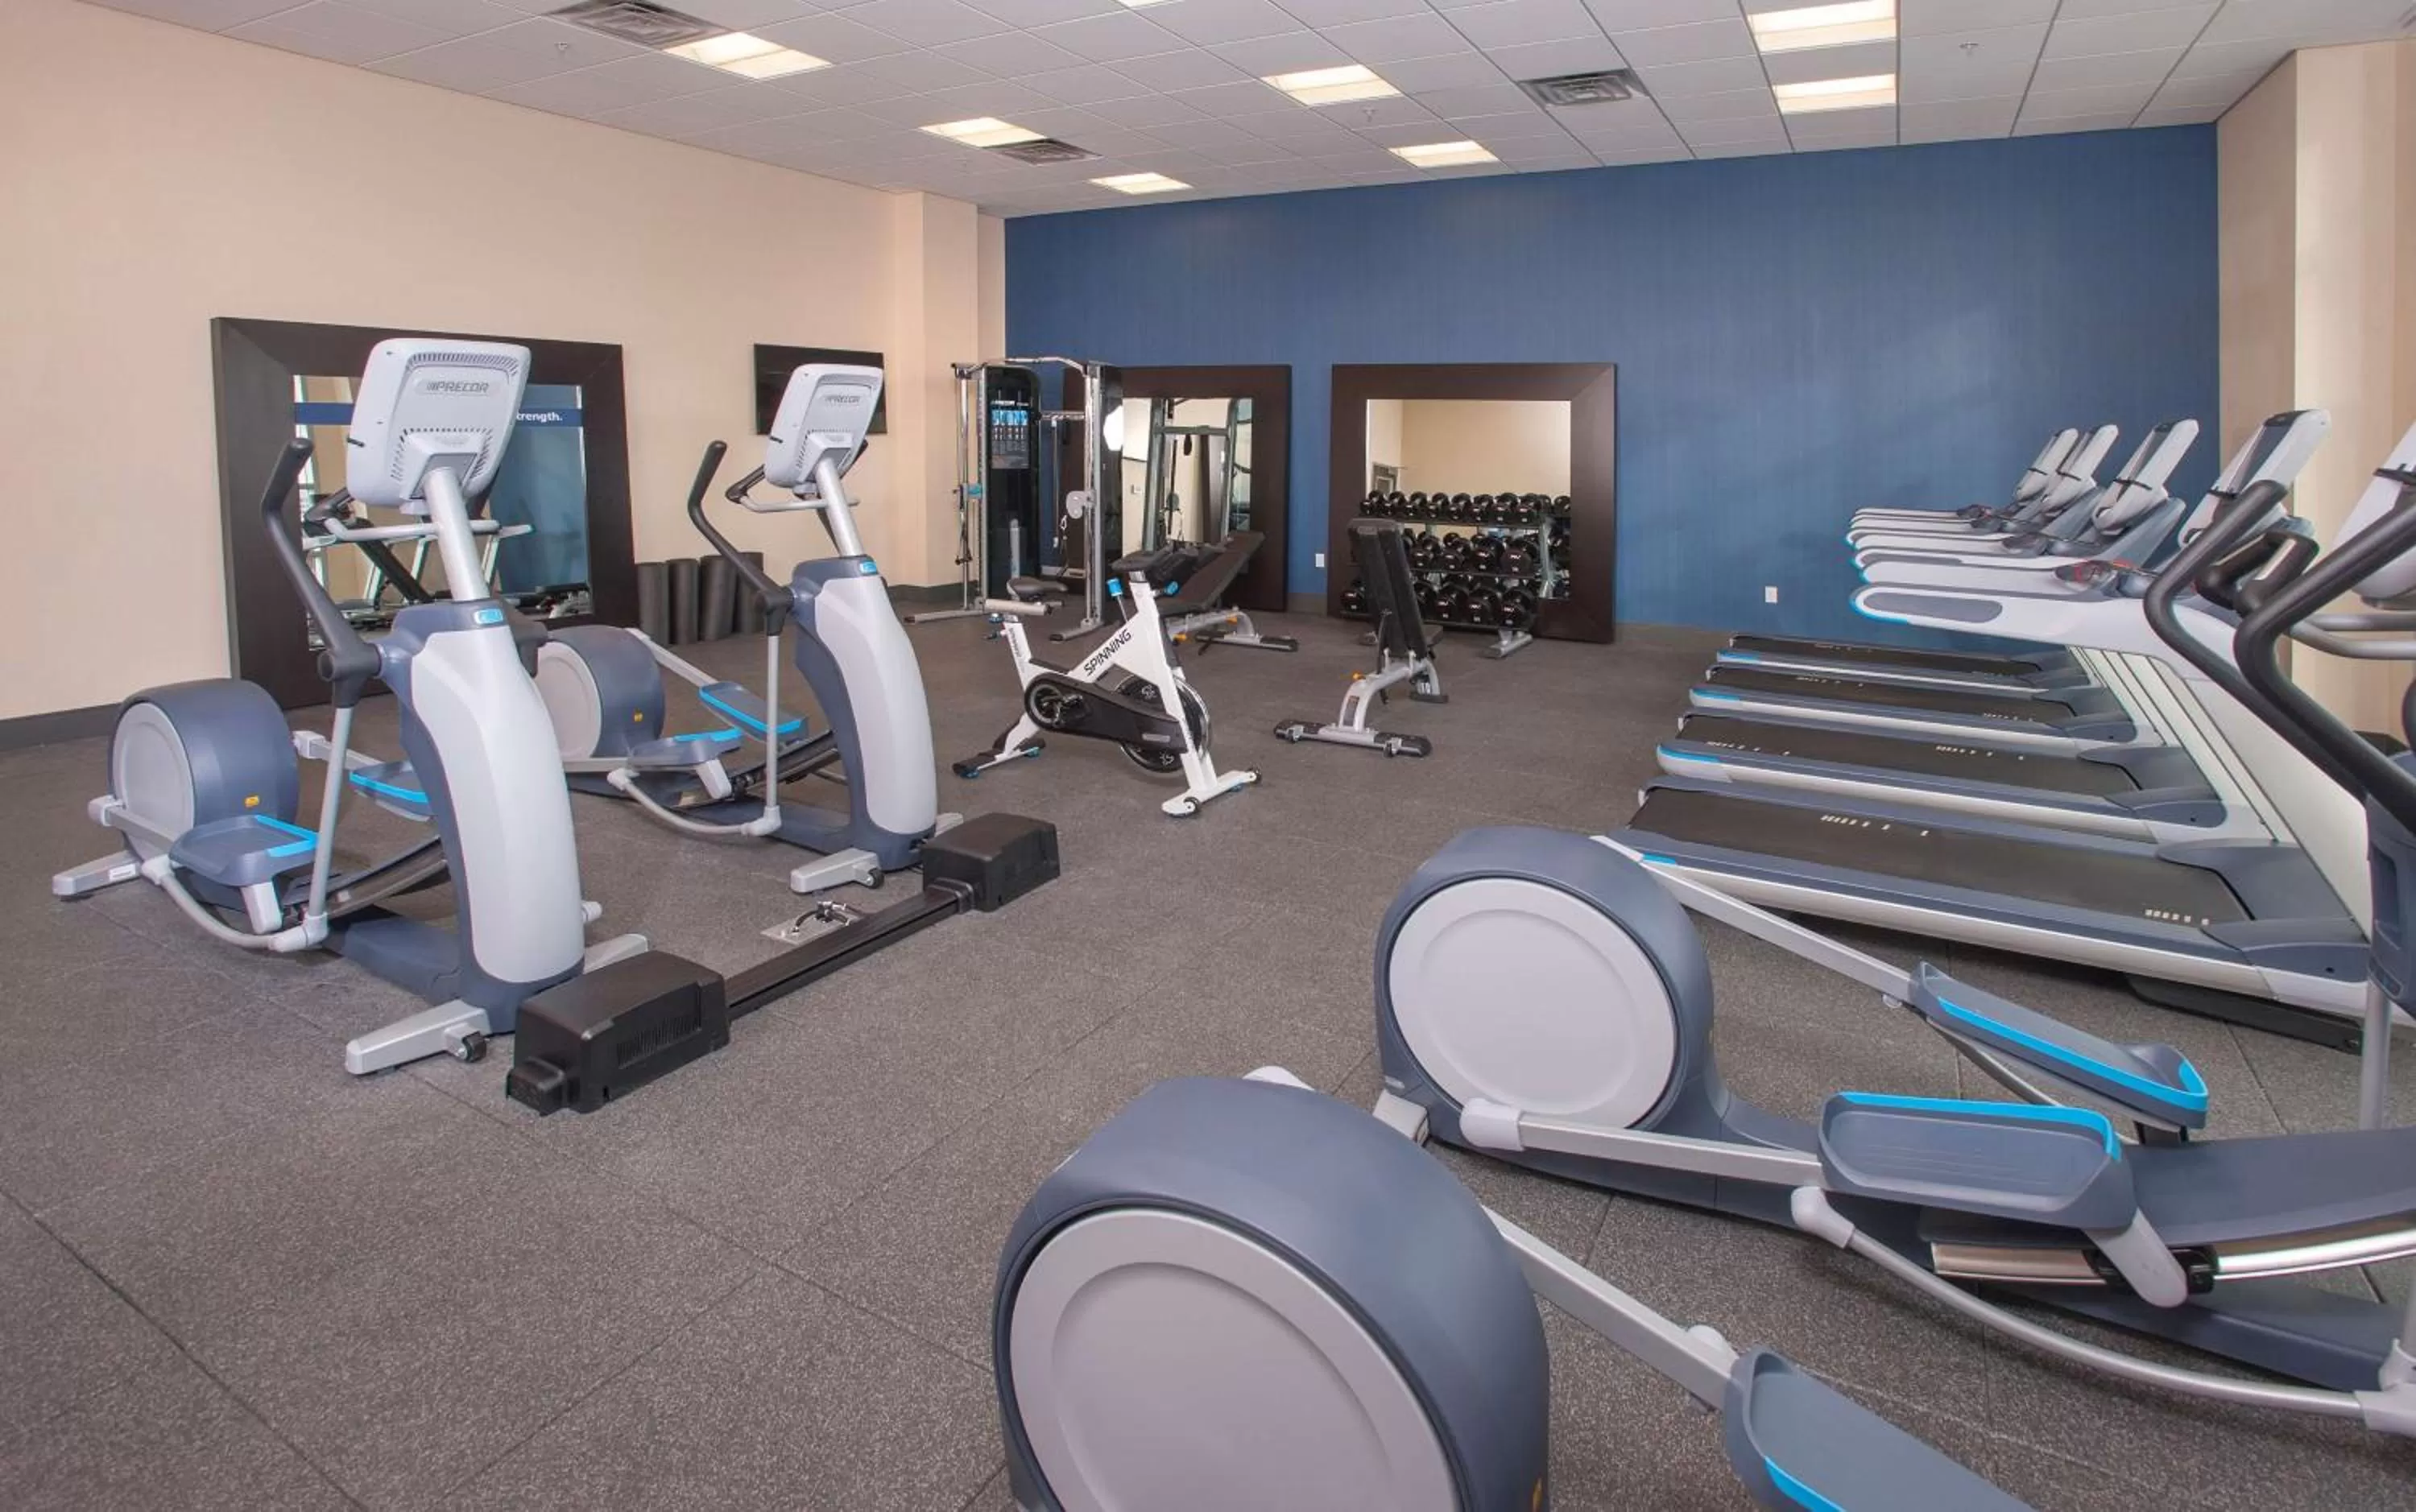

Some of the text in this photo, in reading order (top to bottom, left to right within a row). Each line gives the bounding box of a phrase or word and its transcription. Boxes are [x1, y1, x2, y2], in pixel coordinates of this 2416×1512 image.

[436, 381, 489, 392] PRECOR
[516, 411, 563, 423] trength.
[1084, 628, 1131, 676] SPINNING
